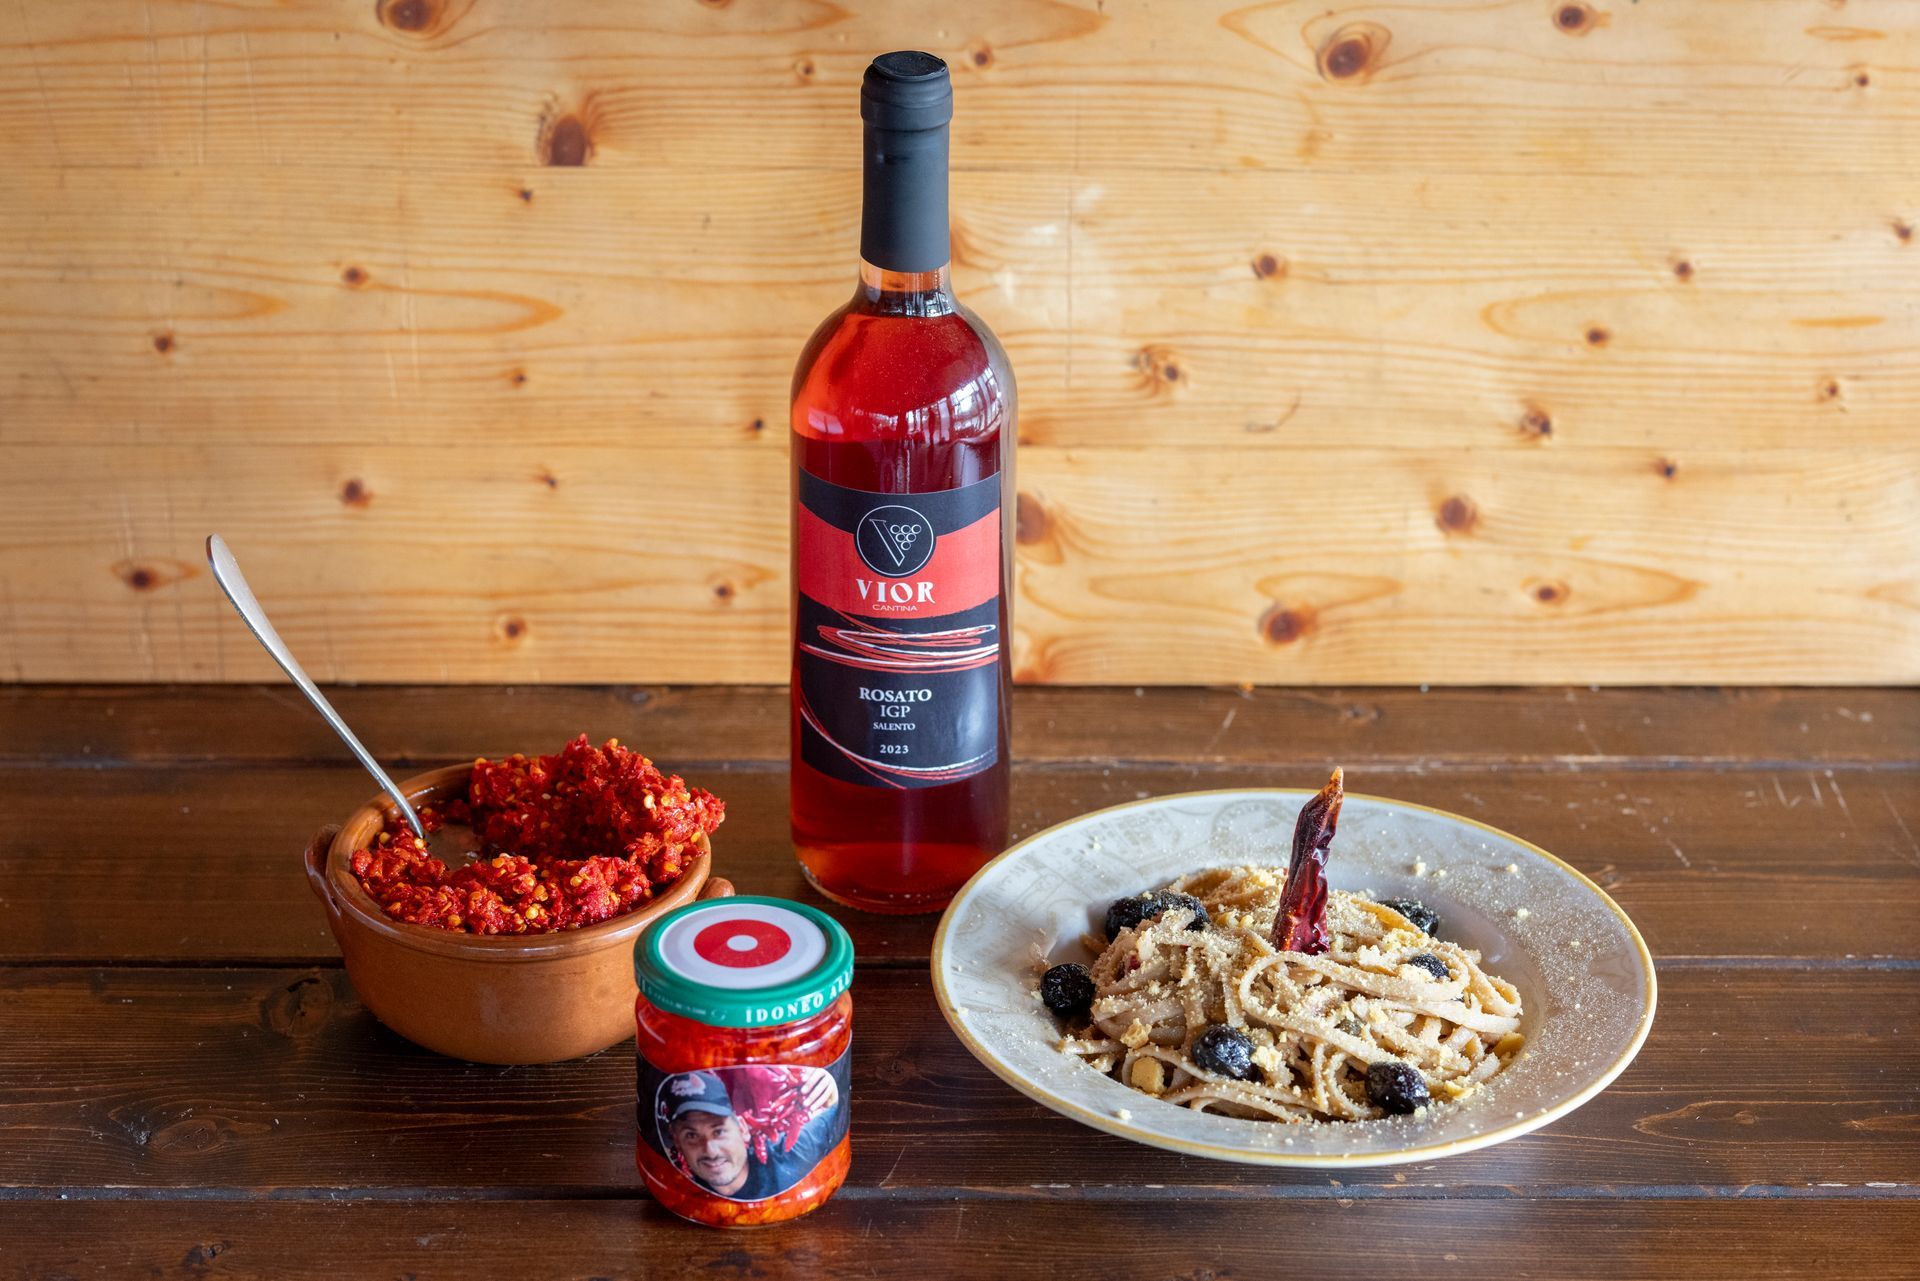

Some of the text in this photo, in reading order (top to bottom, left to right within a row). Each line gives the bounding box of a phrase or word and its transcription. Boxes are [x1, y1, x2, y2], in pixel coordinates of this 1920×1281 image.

[856, 578, 936, 604] VIOR
[872, 604, 918, 612] CANTINA
[859, 687, 932, 702] ROSATO
[880, 705, 911, 718] IGP
[873, 721, 916, 731] SALENTO
[880, 744, 909, 754] 2023
[746, 991, 824, 1023] IDONEO
